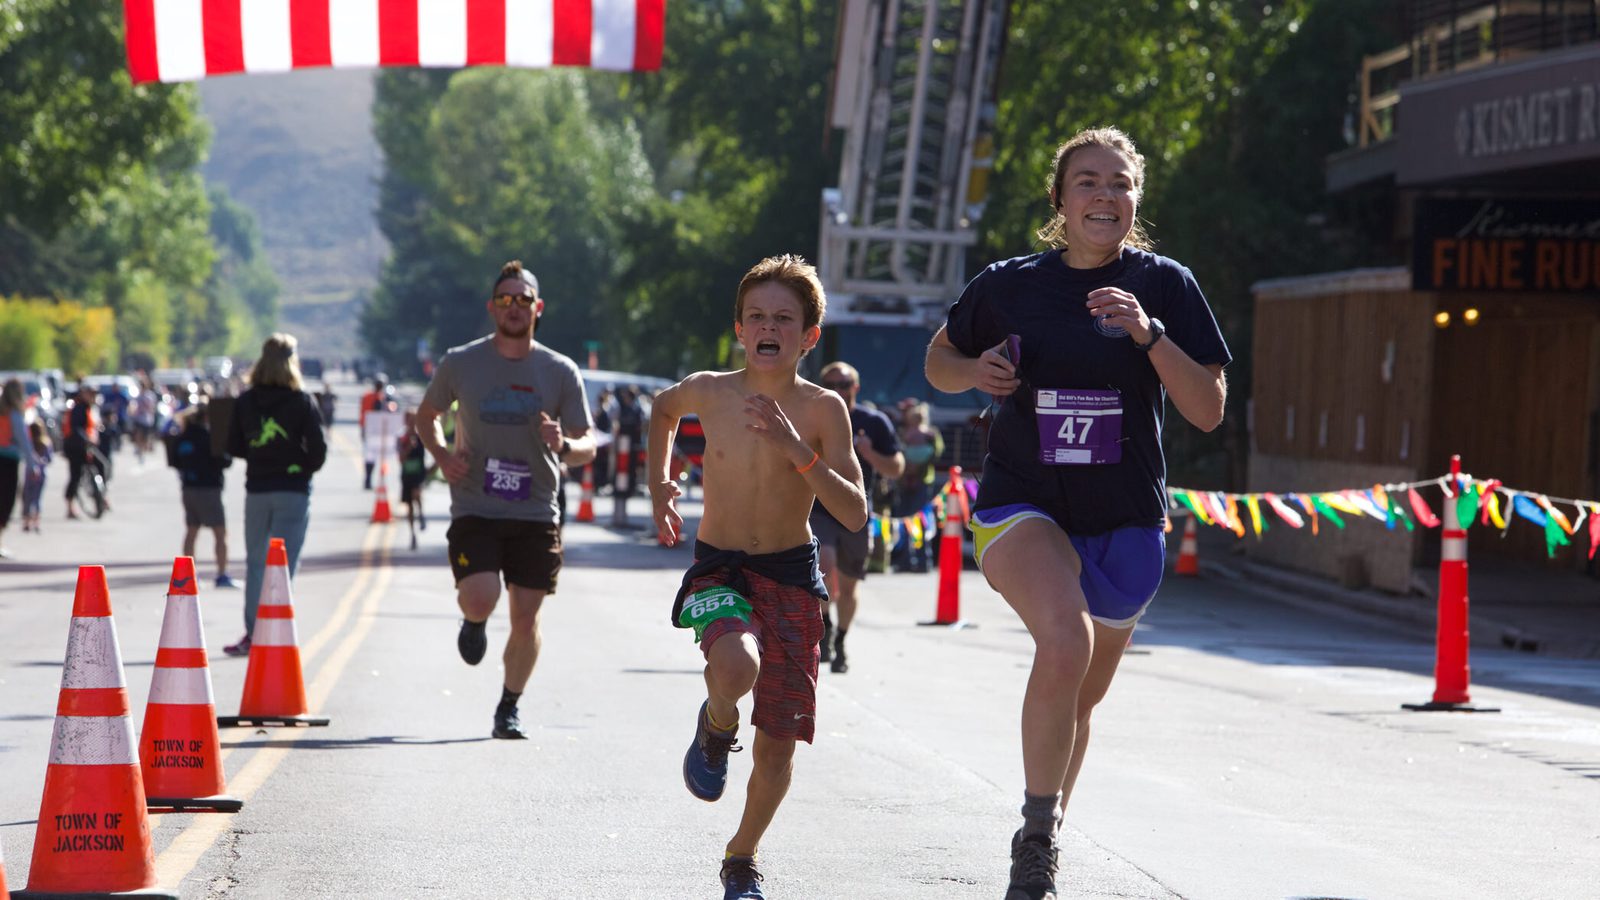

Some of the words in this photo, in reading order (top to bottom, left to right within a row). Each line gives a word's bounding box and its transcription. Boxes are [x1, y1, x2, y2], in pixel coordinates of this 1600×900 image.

[1472, 87, 1572, 156] KISMET
[1578, 83, 1600, 142] R
[1432, 239, 1527, 288] FINE
[1535, 239, 1600, 289] RU
[1057, 416, 1094, 444] 47
[492, 474, 521, 491] 235
[691, 595, 736, 619] 654
[153, 739, 185, 753] TOWN
[189, 740, 203, 752] OF
[151, 756, 204, 768] JACKSON
[55, 813, 97, 831] TOWN
[104, 813, 123, 830] OF
[53, 835, 124, 852] JACKSON
